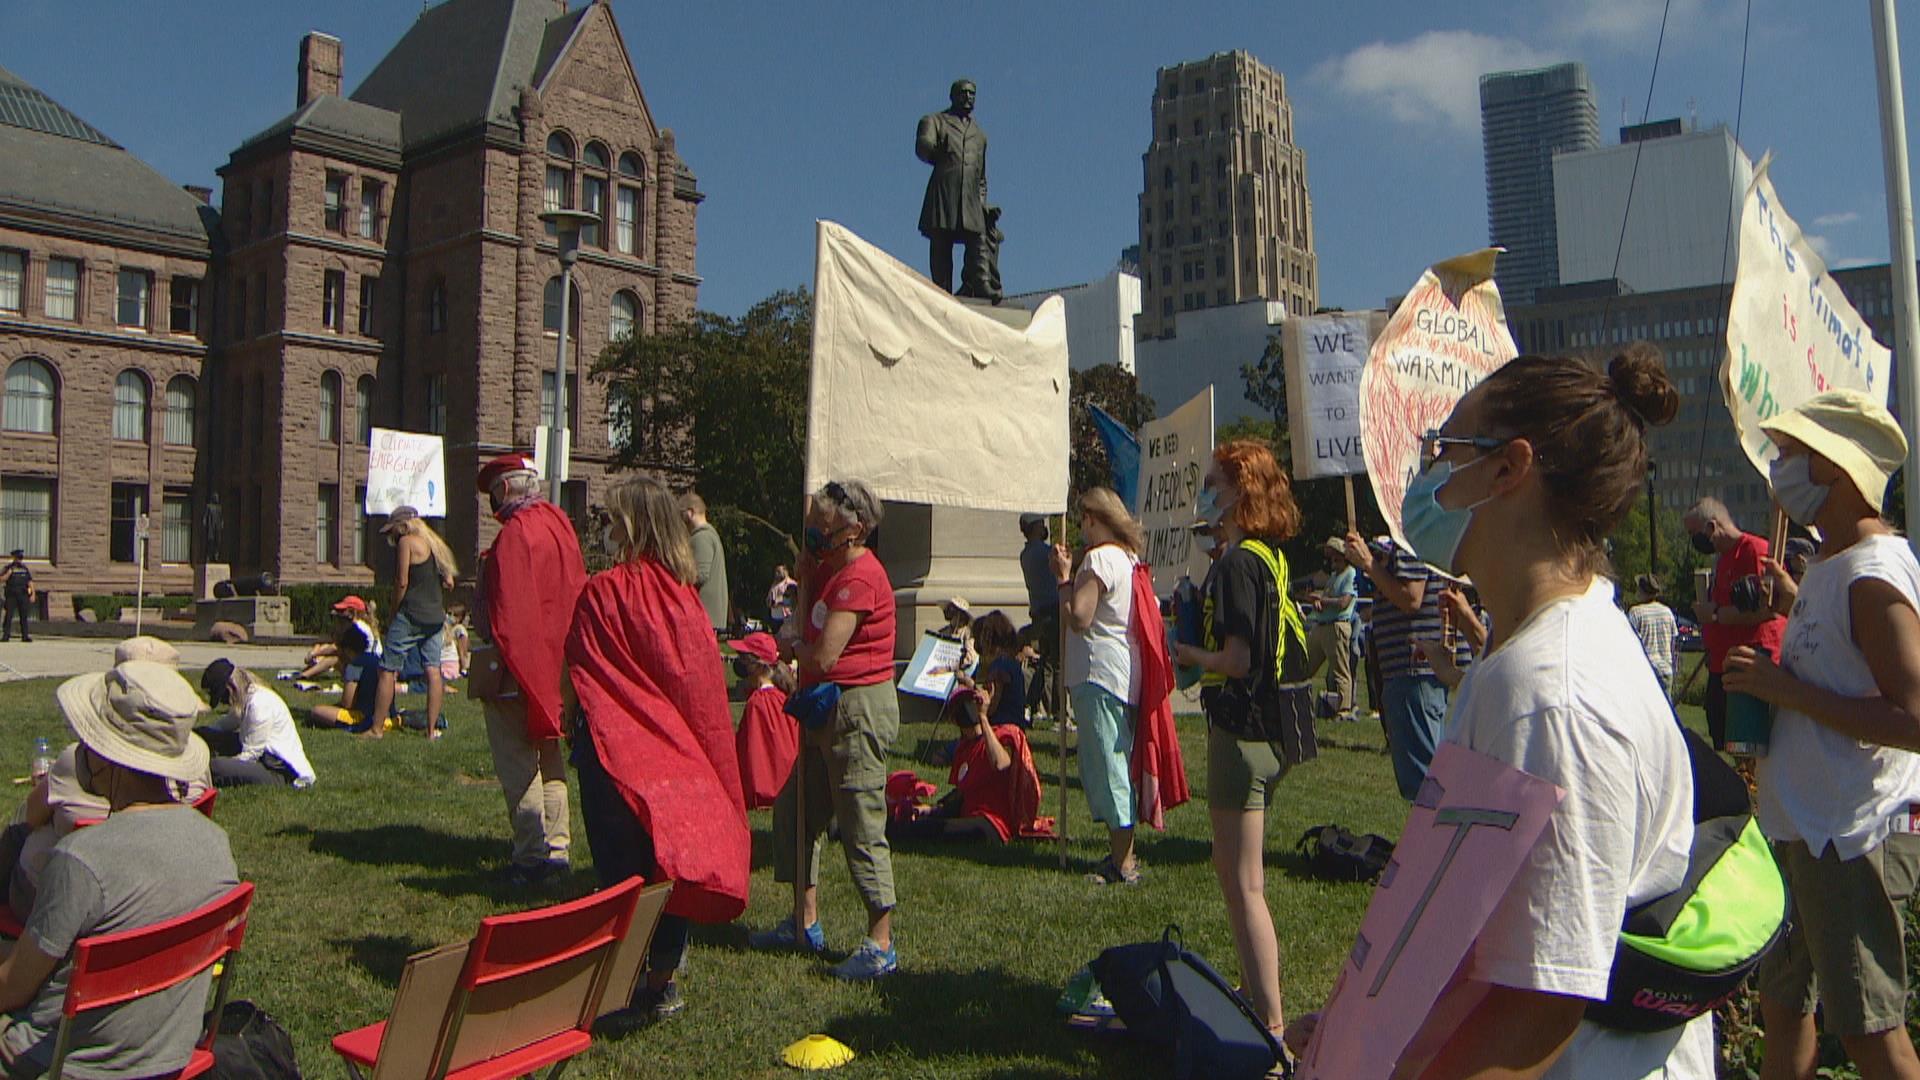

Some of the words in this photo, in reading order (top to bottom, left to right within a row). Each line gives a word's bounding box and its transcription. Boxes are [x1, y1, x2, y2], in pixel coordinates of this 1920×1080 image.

[1756, 185, 1796, 274] The
[1313, 332, 1355, 354] WE
[1416, 308, 1495, 357] GLOBAL
[1783, 293, 1797, 343] is
[1806, 343, 1832, 394] cha
[1308, 370, 1357, 387] WANT
[1391, 350, 1479, 393] WARMIN
[1739, 342, 1779, 422] Wh
[1325, 408, 1346, 421] TO
[1315, 436, 1362, 460] LIVE
